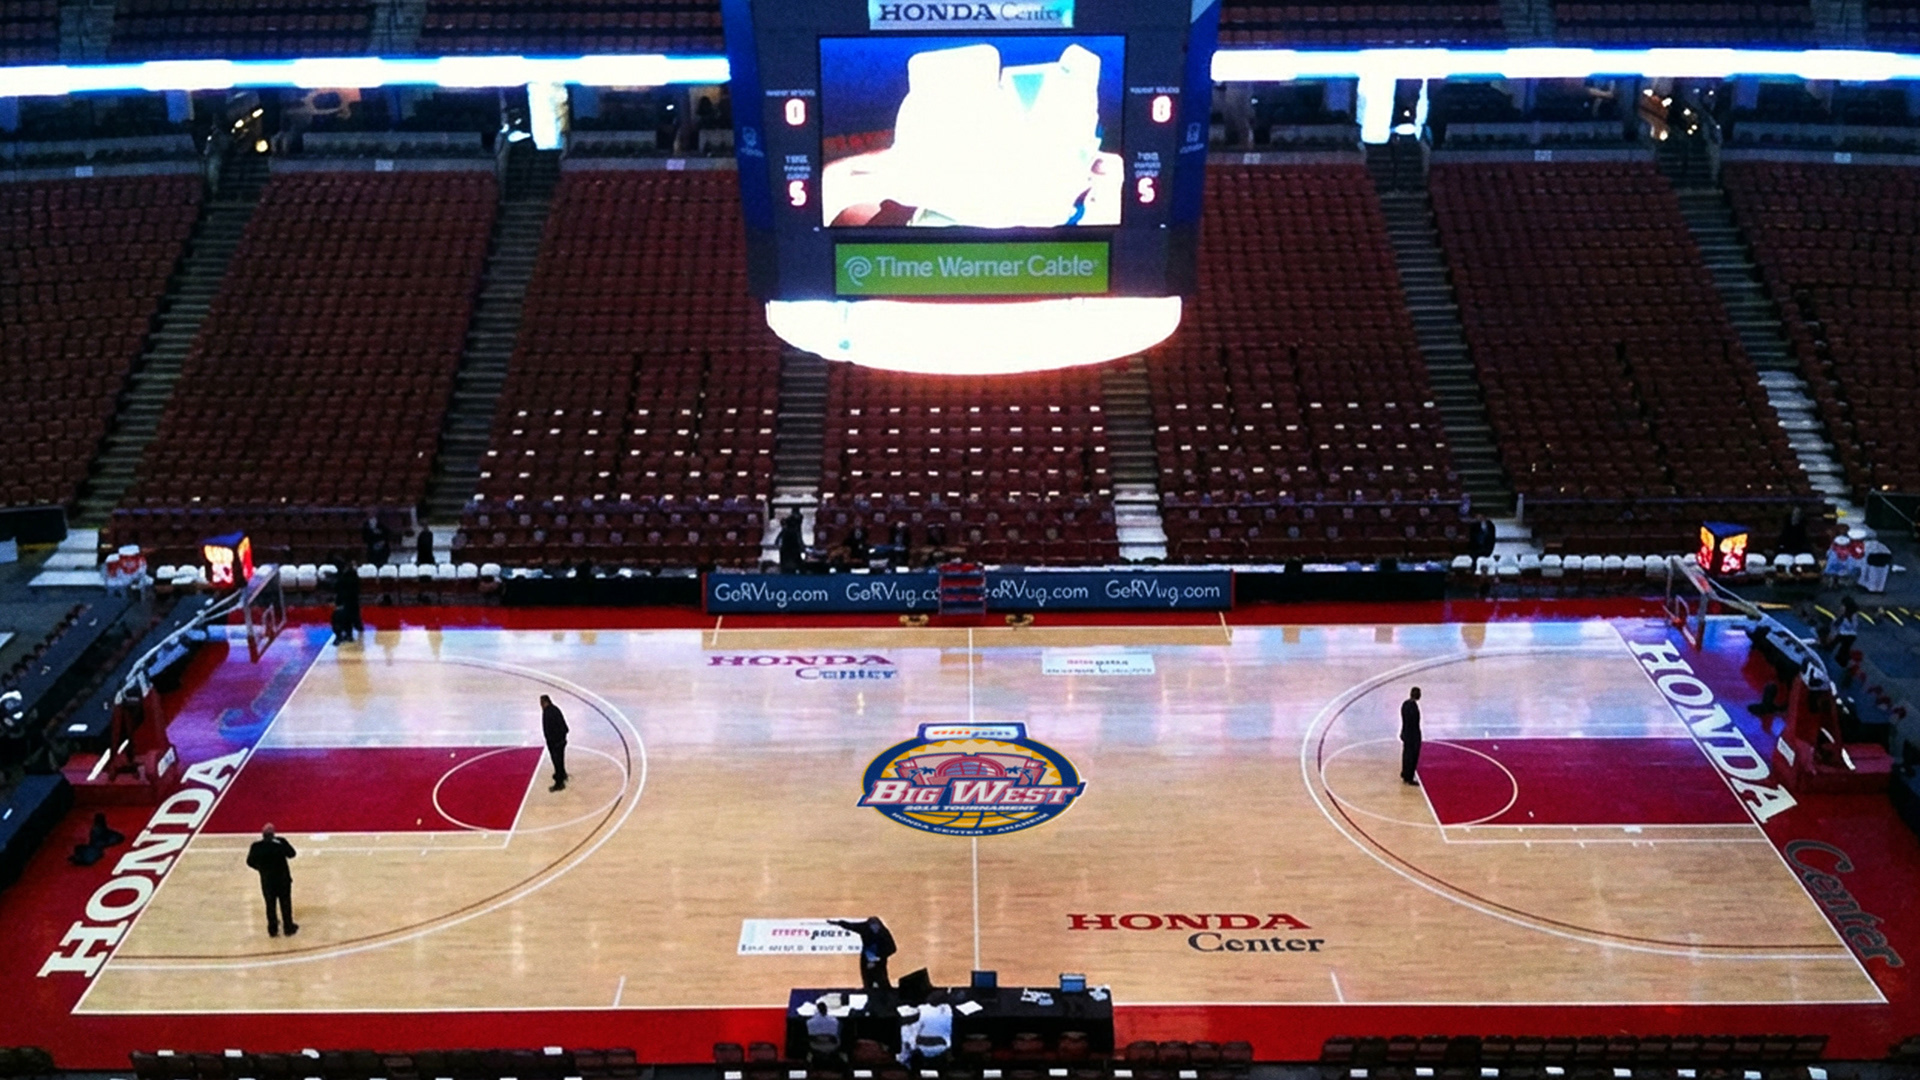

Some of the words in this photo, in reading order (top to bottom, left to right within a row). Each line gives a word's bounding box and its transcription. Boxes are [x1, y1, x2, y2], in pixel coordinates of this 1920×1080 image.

[879, 3, 997, 21] HONDA
[876, 256, 933, 277] Time
[938, 256, 1023, 277] Warner
[1027, 255, 1094, 277] Cable
[708, 655, 894, 666] HONDA
[864, 780, 944, 805] BIG
[950, 780, 1078, 805] WEST
[1628, 639, 1798, 823] HONDA
[1784, 839, 1904, 968] Center
[891, 812, 930, 830] HONDA
[933, 826, 984, 836] CENTER
[996, 812, 1049, 833] ANAHEIM
[36, 747, 249, 977] HONDA
[1066, 913, 1312, 930] HONDA
[1188, 932, 1325, 952] Center
